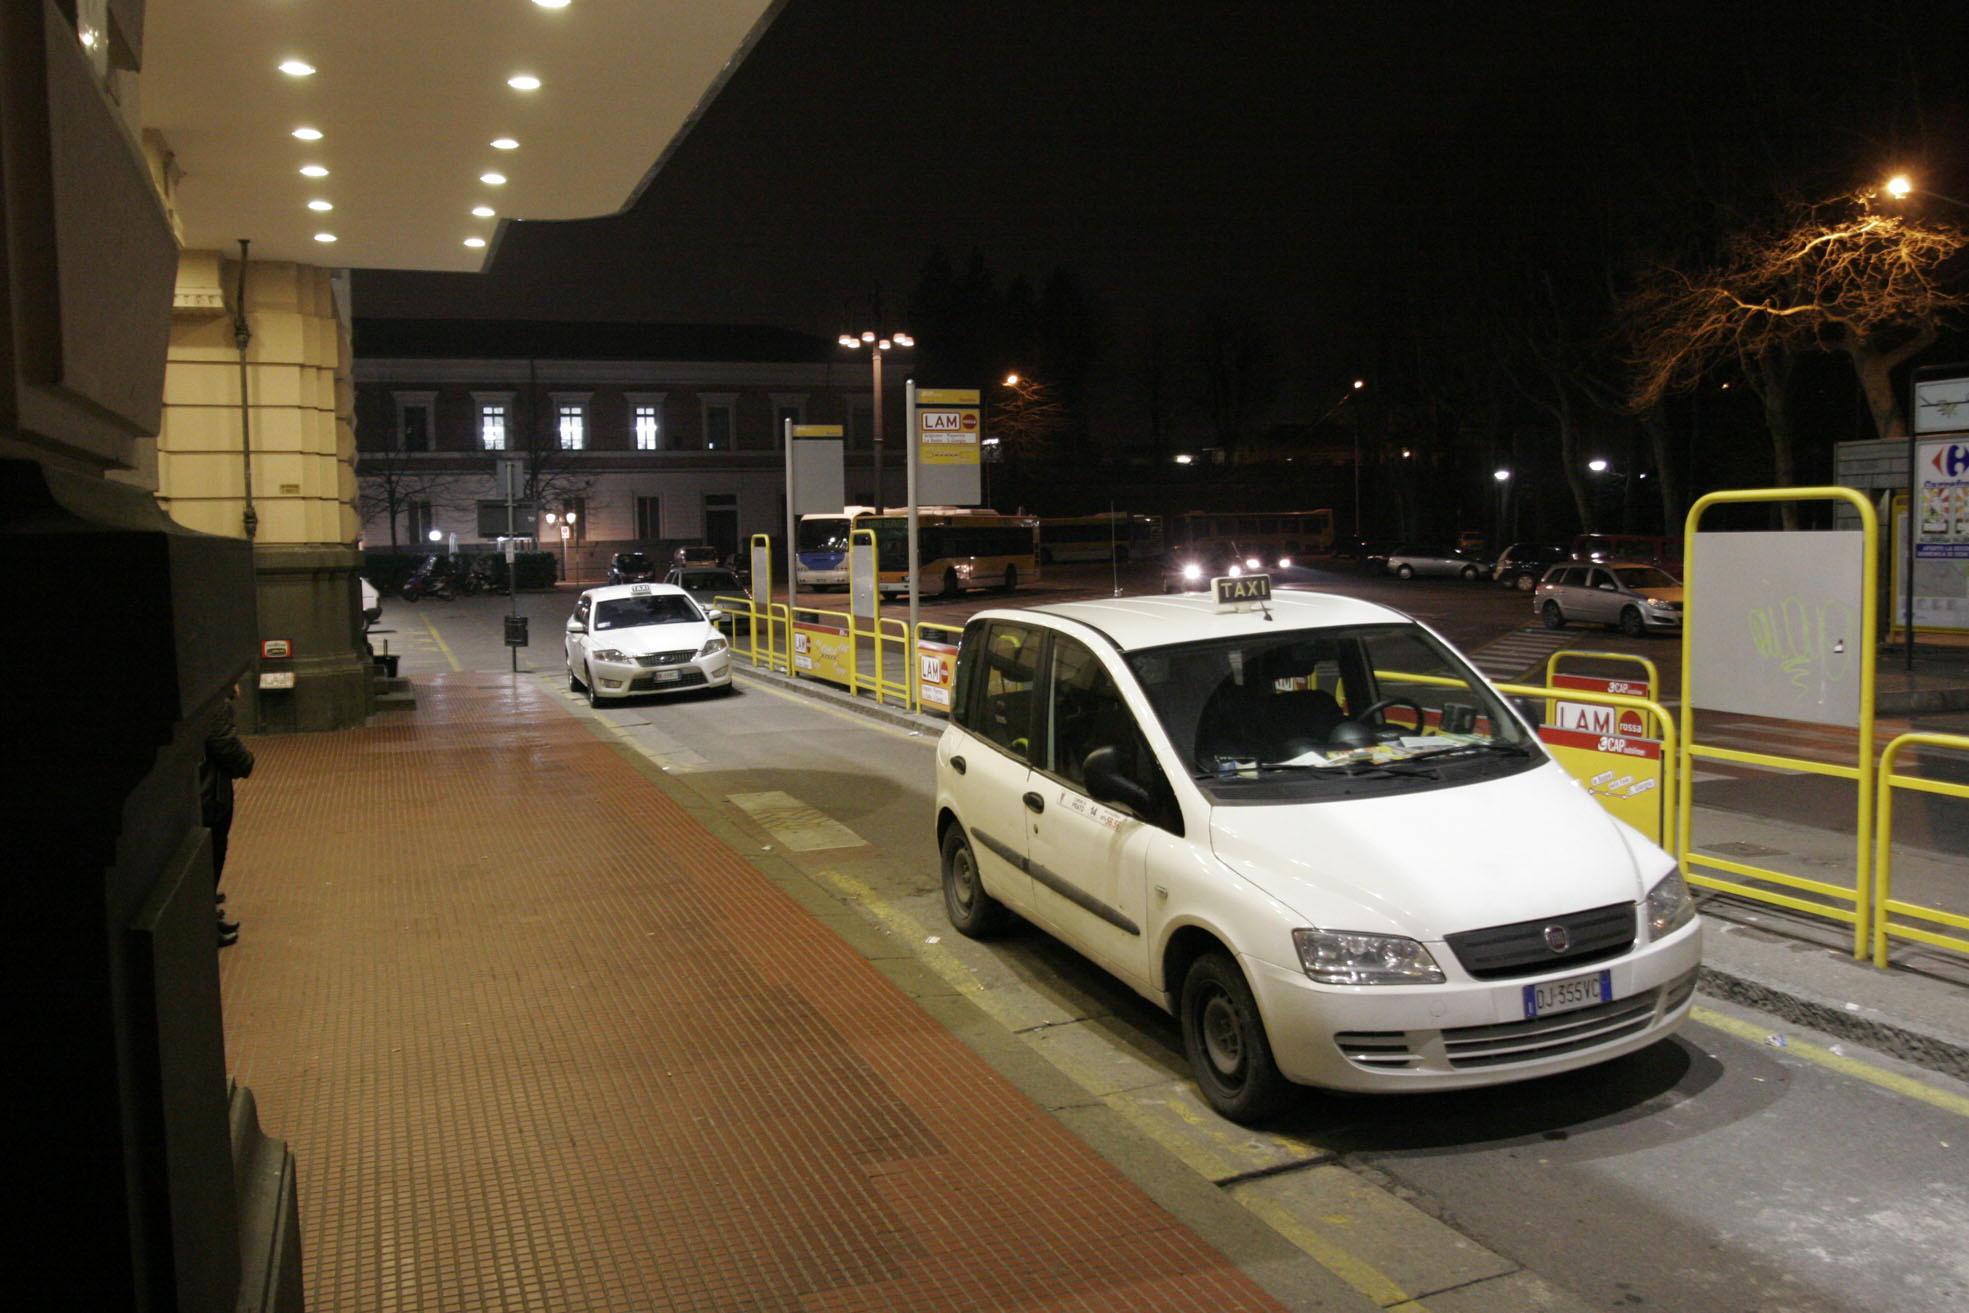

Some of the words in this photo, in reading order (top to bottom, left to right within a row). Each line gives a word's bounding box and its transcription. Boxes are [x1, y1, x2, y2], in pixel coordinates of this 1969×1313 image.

[925, 415, 957, 428] LAM
[1221, 580, 1266, 598] TAXI
[922, 657, 938, 681] LAM
[1620, 722, 1642, 733] rossa
